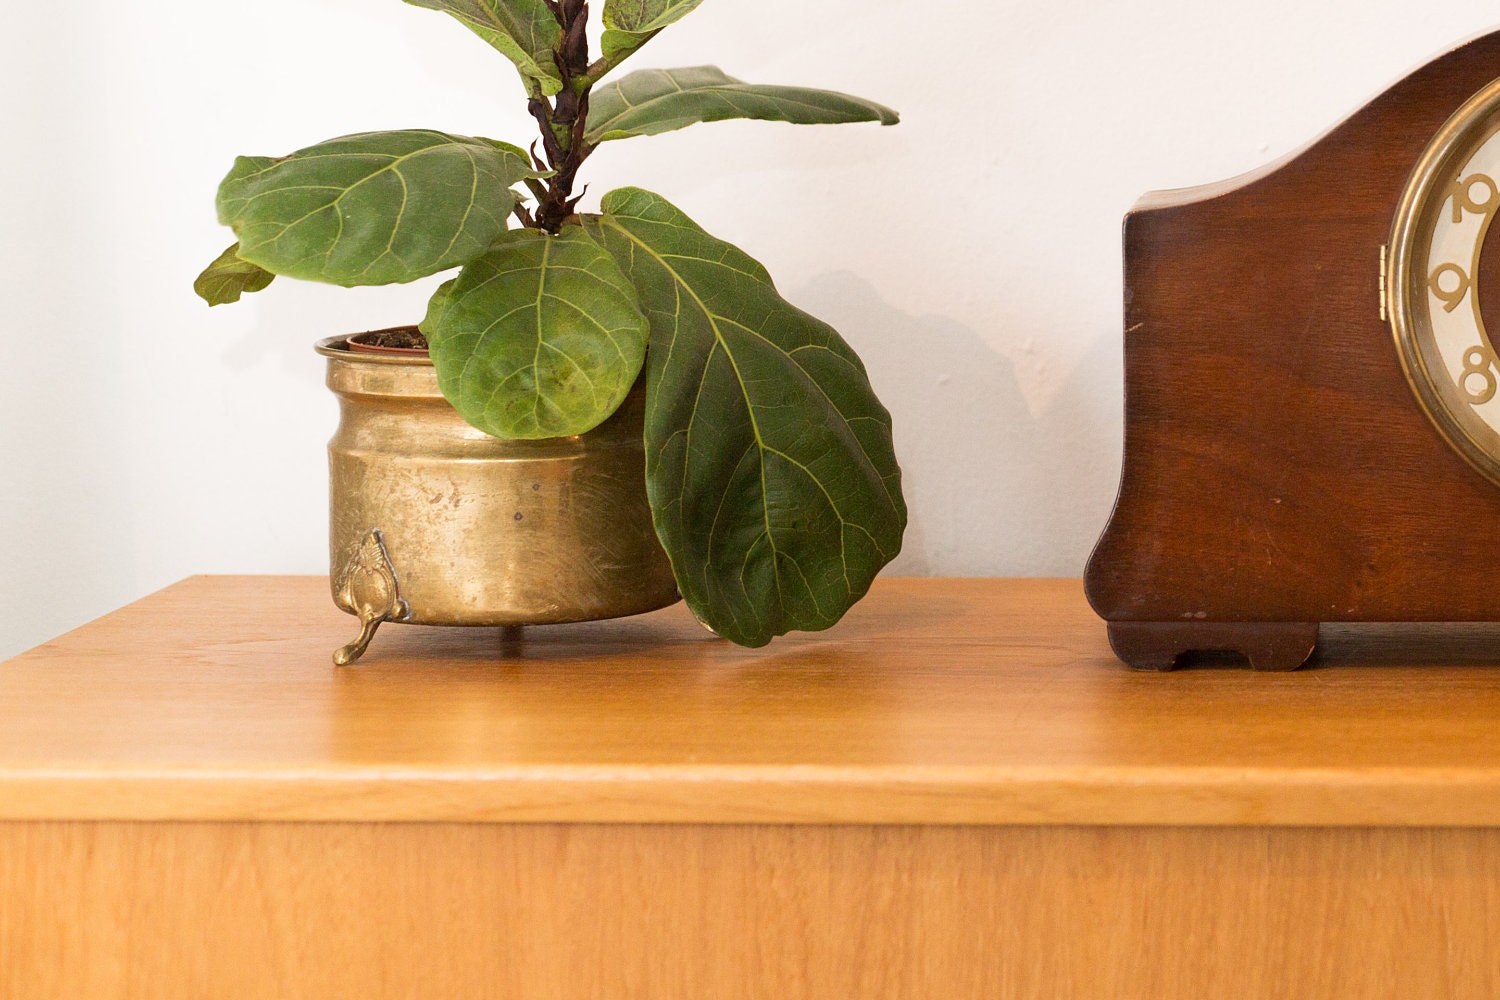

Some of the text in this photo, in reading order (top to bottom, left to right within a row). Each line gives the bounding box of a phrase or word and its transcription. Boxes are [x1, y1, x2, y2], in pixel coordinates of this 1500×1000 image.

[1451, 173, 1499, 223] 10
[1429, 262, 1470, 313] 9
[1459, 346, 1498, 405] 8
